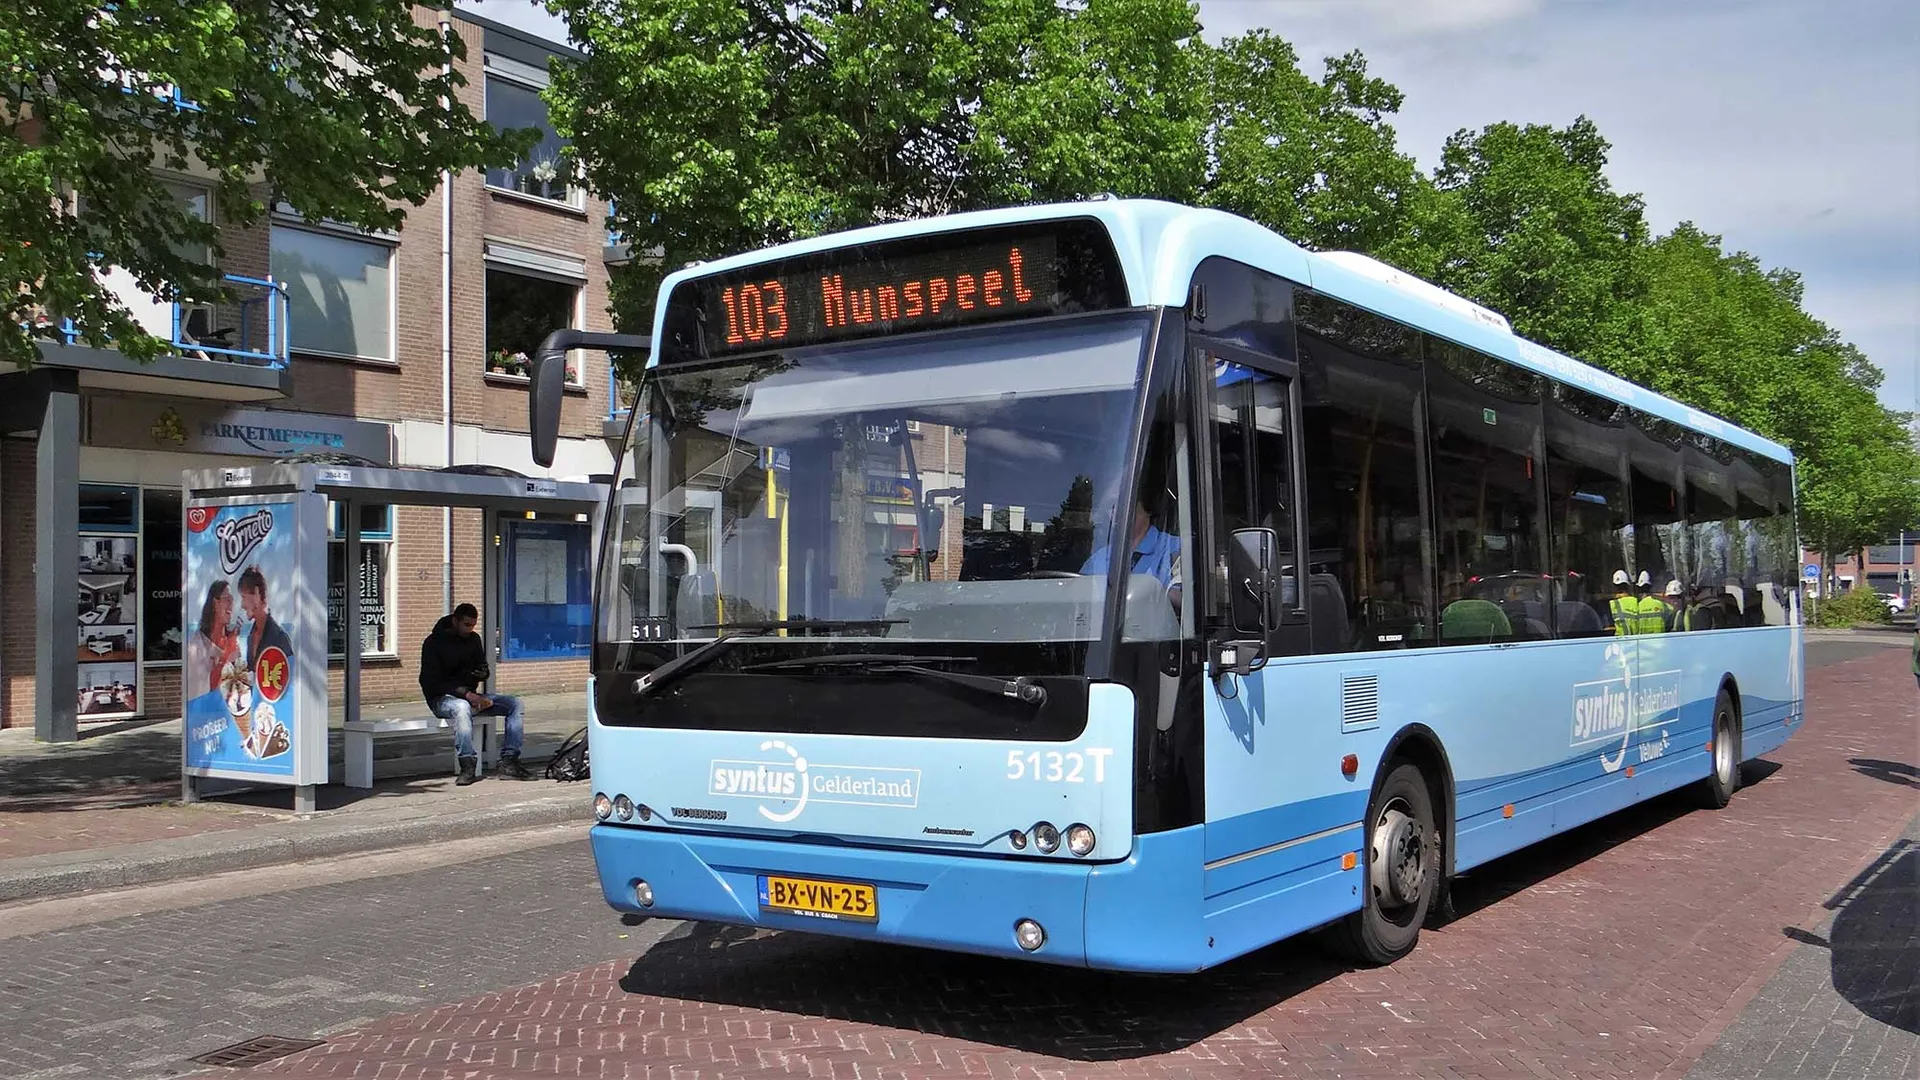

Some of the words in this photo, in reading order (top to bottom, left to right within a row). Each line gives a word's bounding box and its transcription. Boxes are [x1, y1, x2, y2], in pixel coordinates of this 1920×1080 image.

[722, 280, 790, 344] 103
[821, 247, 1033, 328] Nunspeet
[201, 422, 345, 449] PARKETMEESTER
[216, 509, 273, 574] Cornetto
[632, 625, 661, 639] 511
[1574, 686, 1625, 738] syntus
[1633, 684, 1678, 717] Gelderland
[192, 717, 229, 742] PROBEER
[714, 765, 795, 795] syntus
[812, 775, 914, 798] Gelderland
[774, 881, 868, 913] BX-VN-25
